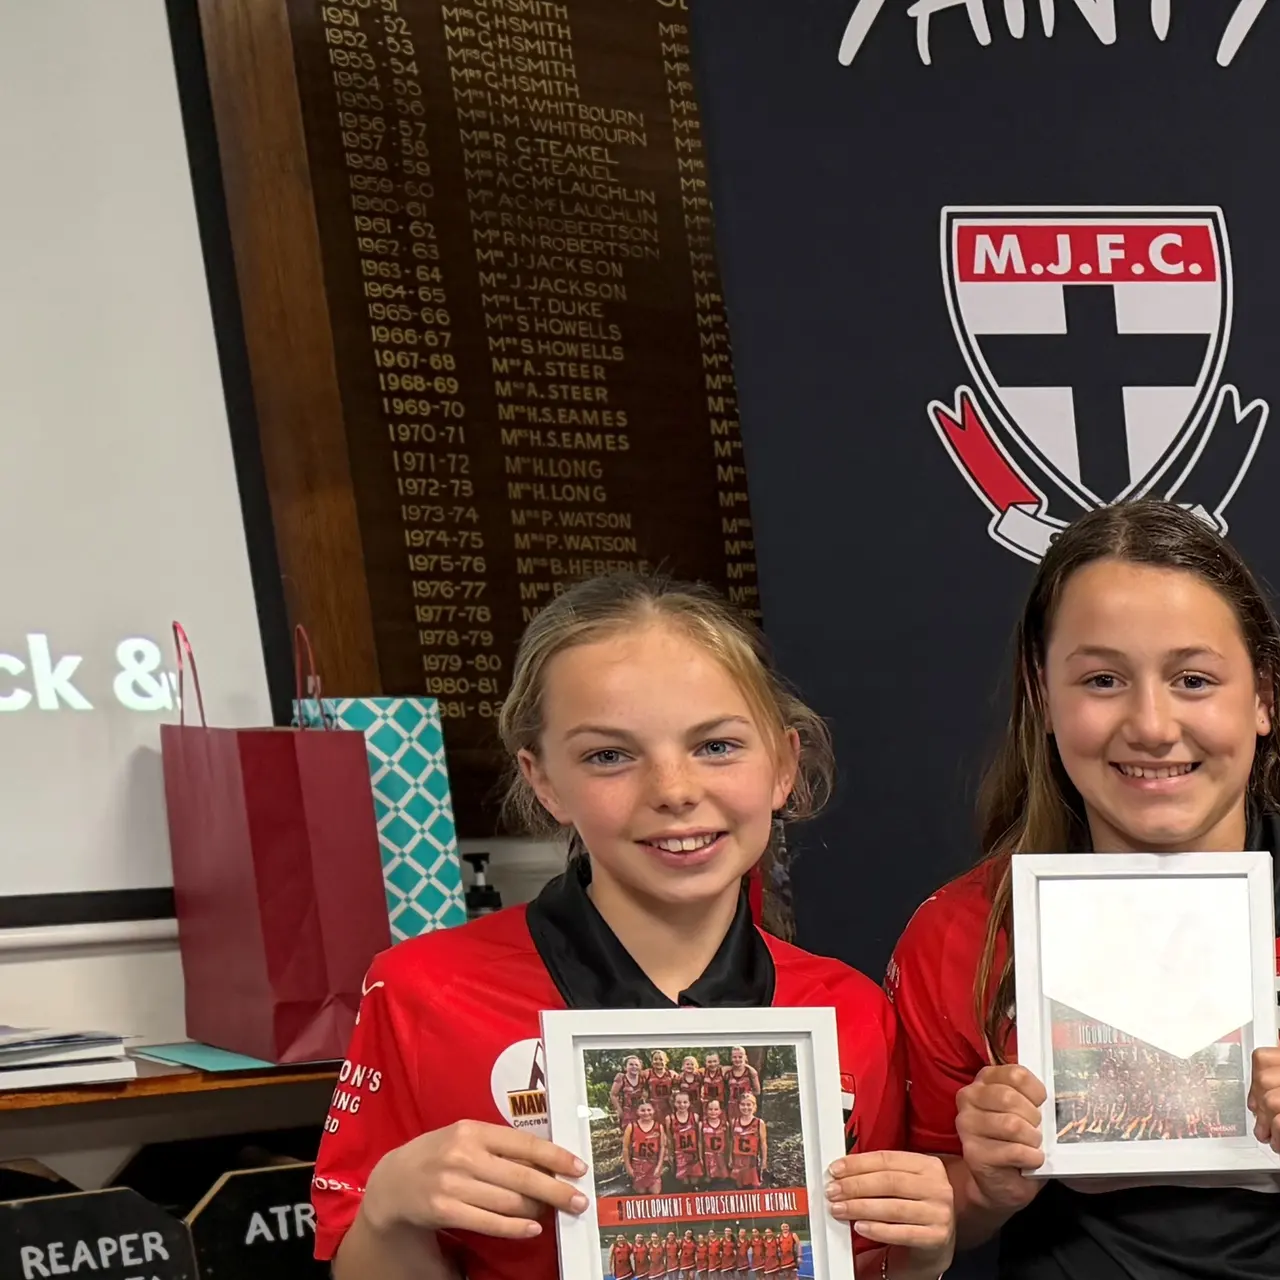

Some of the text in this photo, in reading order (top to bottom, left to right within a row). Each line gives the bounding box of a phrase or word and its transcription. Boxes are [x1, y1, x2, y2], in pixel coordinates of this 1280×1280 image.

[973, 233, 1203, 276] M.J.F.C.
[439, 700, 503, 719] 981-82
[20, 1231, 170, 1280] REAPER
